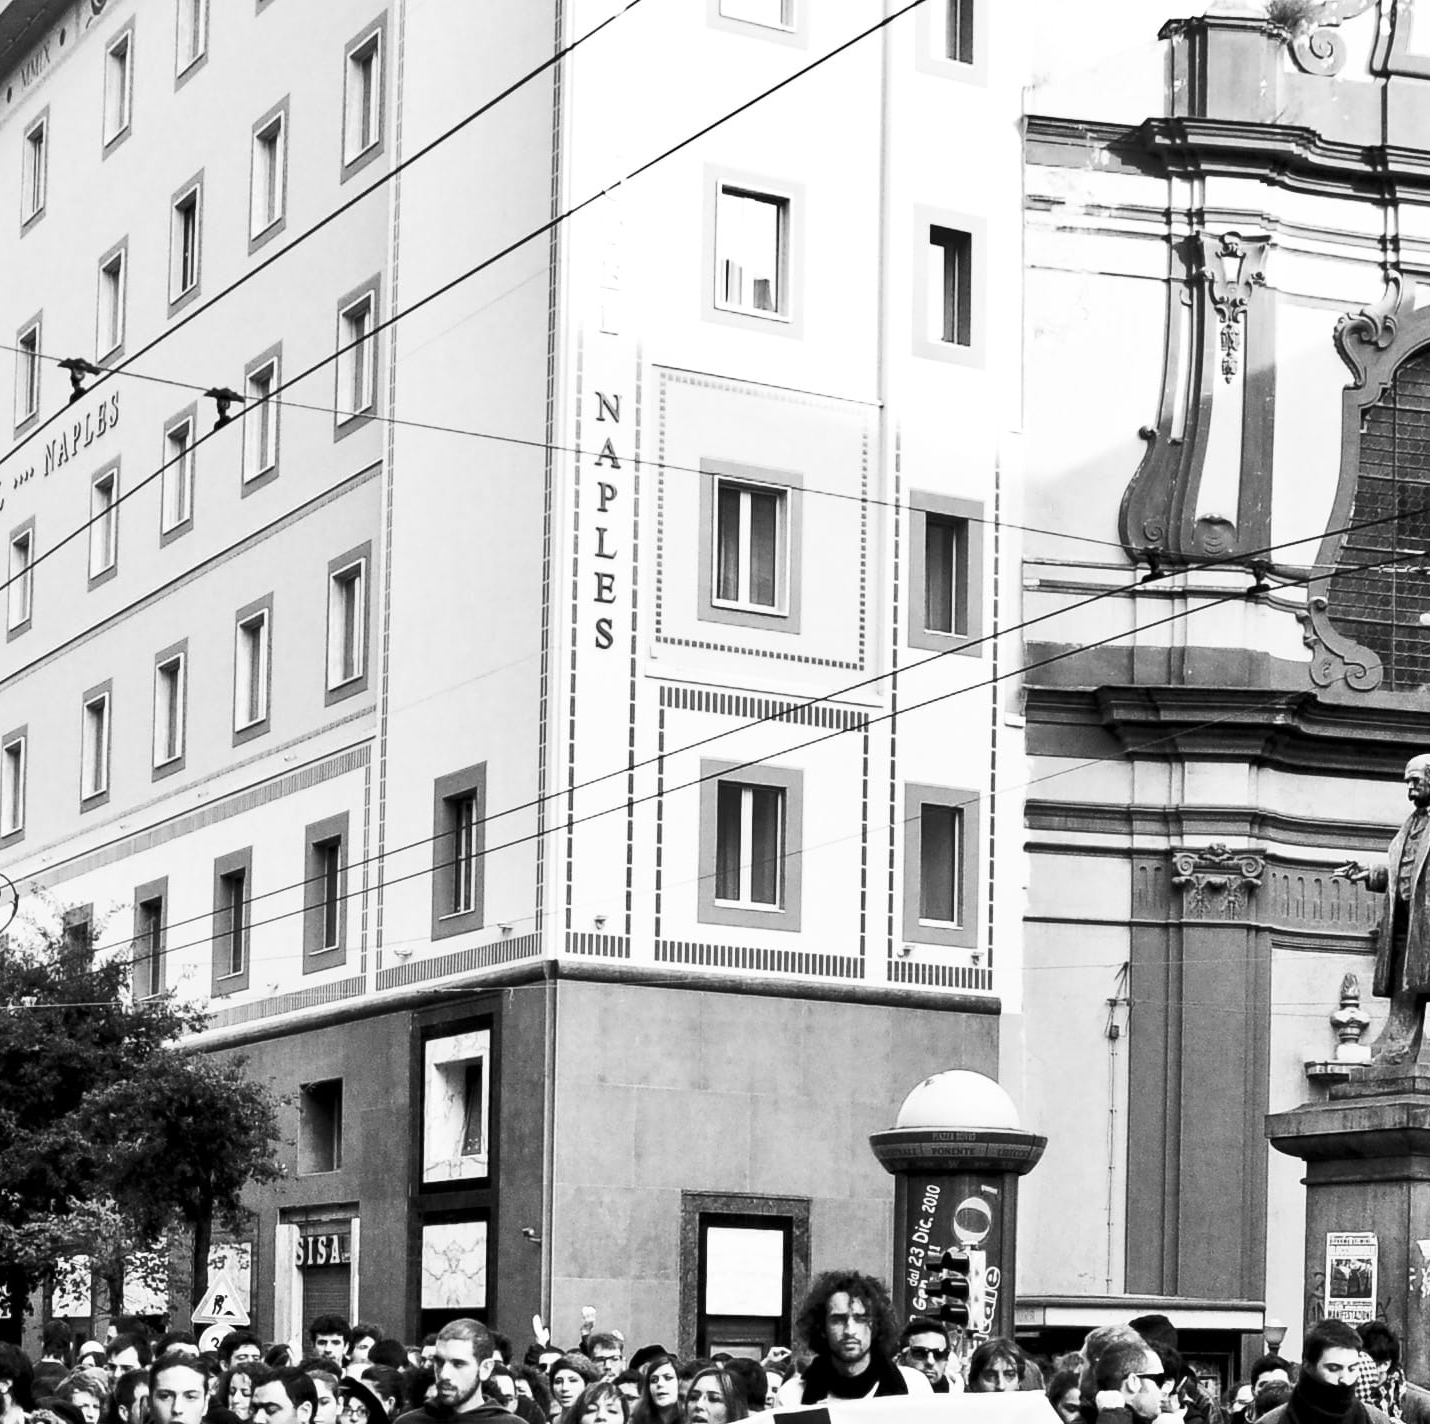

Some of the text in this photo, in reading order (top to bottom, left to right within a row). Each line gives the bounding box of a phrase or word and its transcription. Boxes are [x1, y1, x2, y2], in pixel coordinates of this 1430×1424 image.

[43, 389, 120, 478] NAPLES
[593, 391, 622, 651] NAPLES
[921, 1184, 942, 1214] 2010
[911, 1217, 935, 1245] Dic.
[295, 1233, 341, 1267] SISA
[908, 1246, 926, 1268] 23
